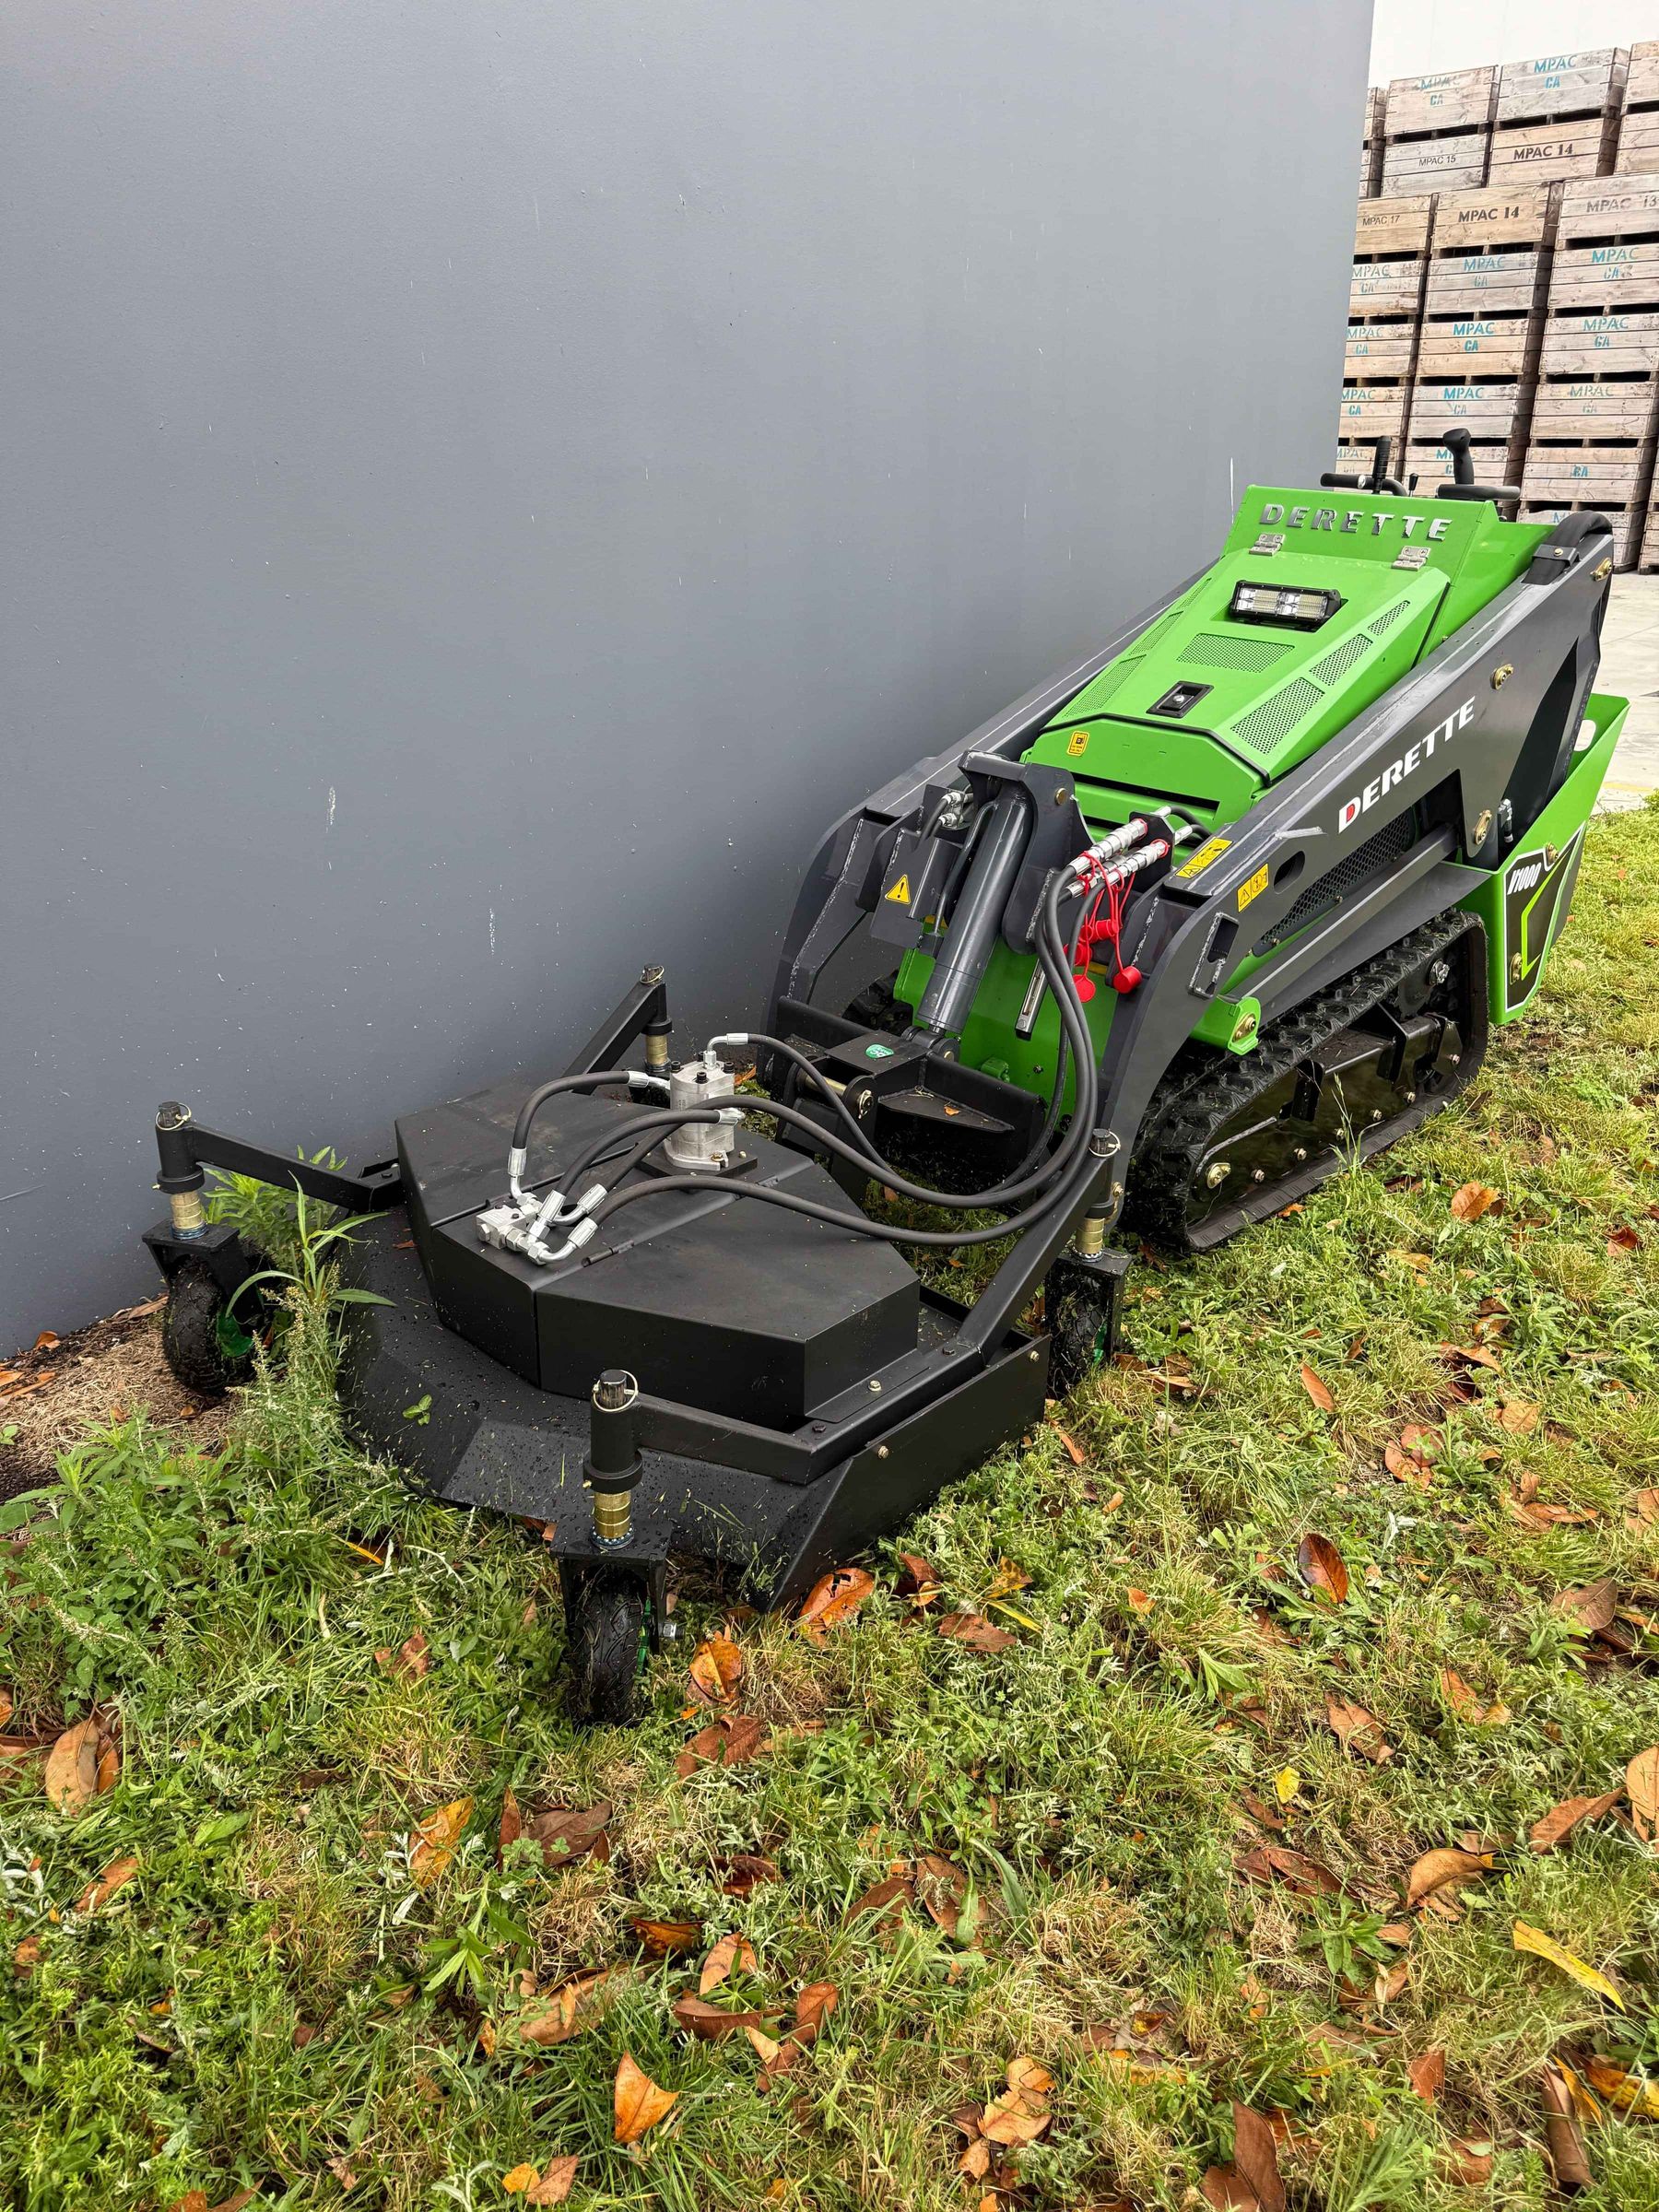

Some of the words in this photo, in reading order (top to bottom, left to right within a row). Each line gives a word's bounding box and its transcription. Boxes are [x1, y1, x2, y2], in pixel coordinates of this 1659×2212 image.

[1534, 55, 1578, 73] MPAC
[1545, 76, 1560, 88] CA
[1430, 94, 1443, 106] CA
[1513, 146, 1552, 160] MPAC
[1558, 144, 1573, 155] 14
[1419, 156, 1444, 166] MPAC
[1446, 155, 1456, 163] 15
[1586, 197, 1631, 213] MPAC
[1458, 208, 1498, 222] MPAC
[1504, 206, 1519, 218] 14
[1362, 216, 1388, 226] MPAC
[1391, 215, 1401, 224] 17
[1592, 247, 1639, 263] MPAC
[1464, 256, 1506, 271] MPAC
[1353, 265, 1391, 277] MPAC
[1453, 322, 1495, 335] MPAC
[1583, 316, 1630, 331] MPAC
[1346, 326, 1384, 338] MPAC
[1356, 344, 1368, 354] CA
[1465, 340, 1478, 351] CA
[1342, 389, 1376, 399] MPAC
[1443, 387, 1485, 399] MPAC
[1570, 384, 1614, 397] MPAC
[1348, 406, 1361, 415] CA
[1453, 404, 1466, 415] CA
[1259, 503, 1453, 541] DERETTE
[1338, 695, 1476, 834] DERETTE
